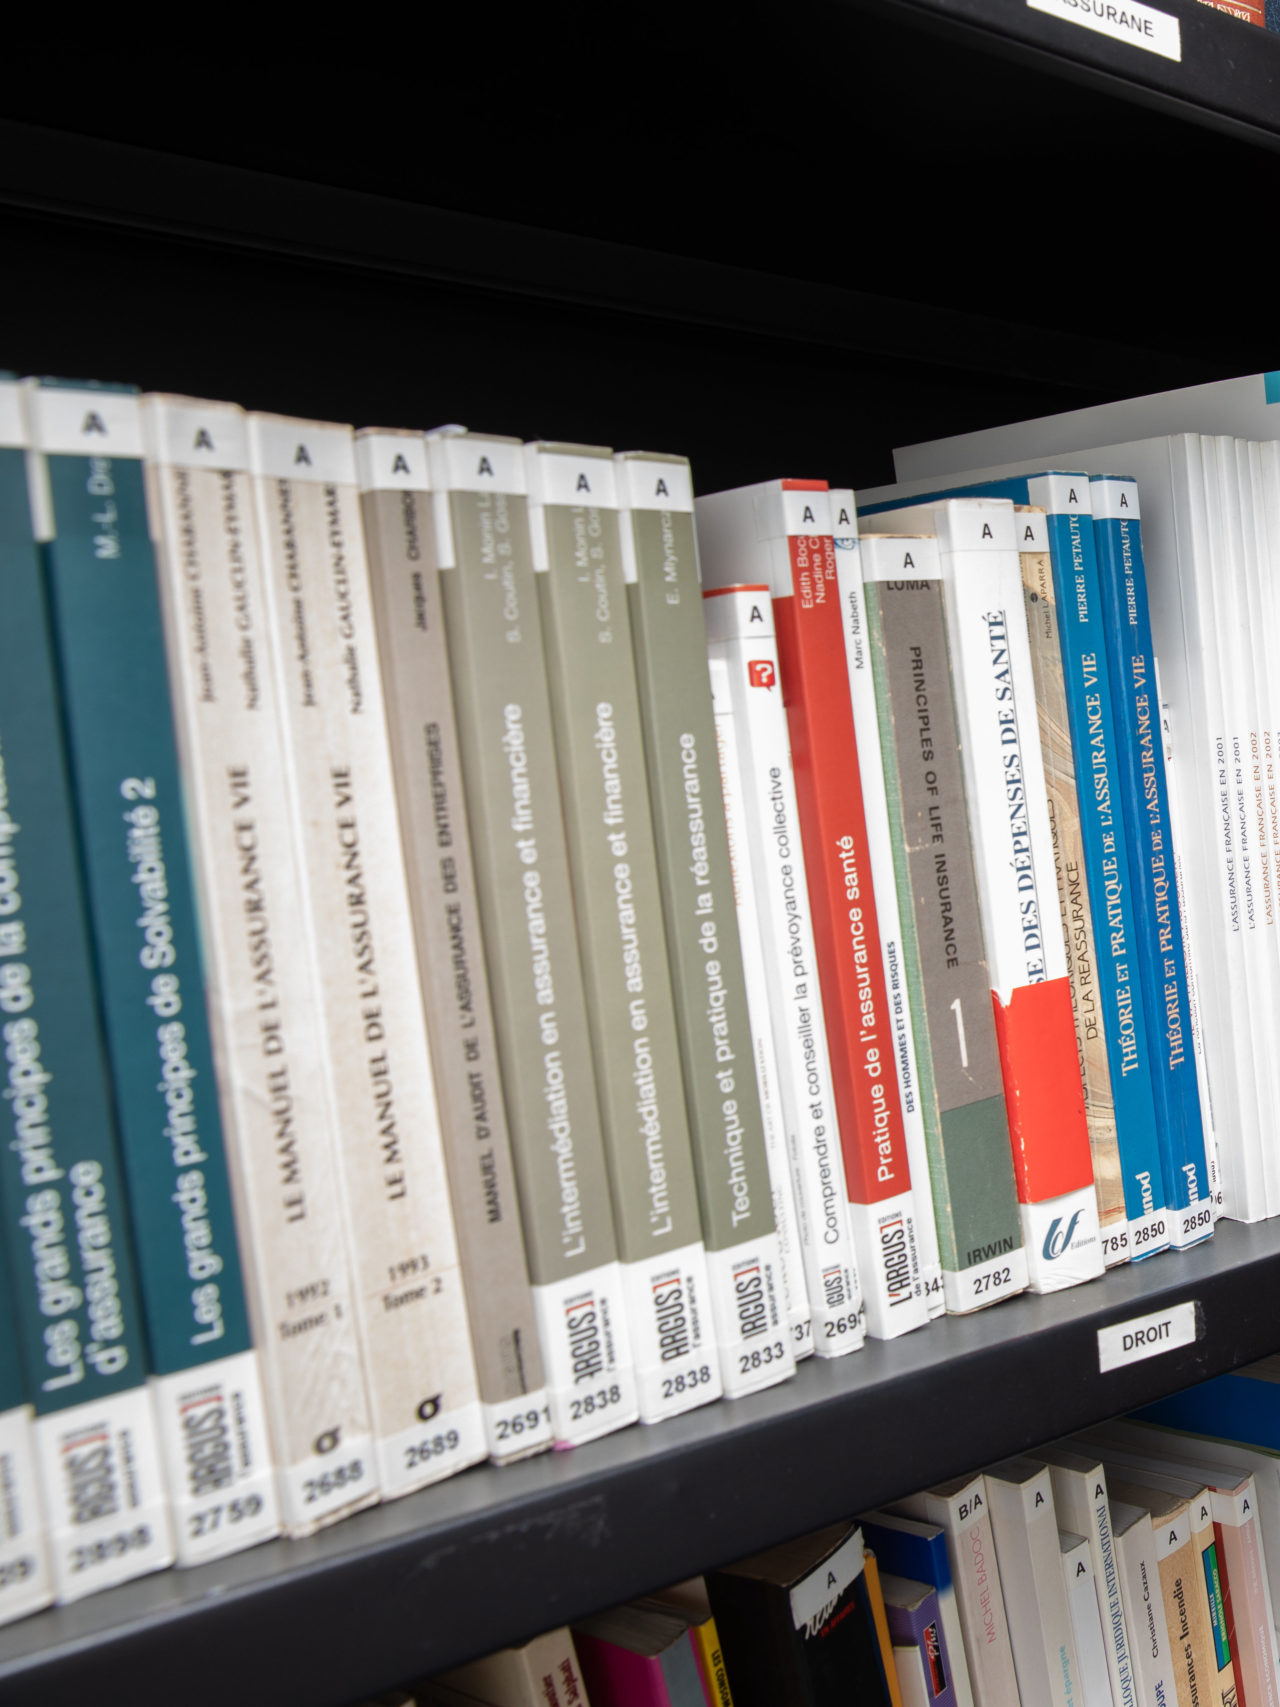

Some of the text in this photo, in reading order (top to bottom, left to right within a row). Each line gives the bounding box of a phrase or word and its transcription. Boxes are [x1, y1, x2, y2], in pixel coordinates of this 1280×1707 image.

[1062, 0, 1154, 38] SSURANE
[812, 549, 826, 604] Nadine
[823, 536, 836, 581] Roger
[801, 577, 814, 609] Edith
[847, 590, 866, 670] Marc Nabeth
[1216, 735, 1226, 765] 2001
[1219, 771, 1227, 786] EN
[1232, 735, 1242, 764] 2001
[1236, 770, 1243, 785] EN
[909, 646, 959, 969] PRINCIPLES OF LIFE INSURANCE
[982, 608, 1042, 962] DES DÉPENSES DE SANTÉ
[120, 775, 177, 970] Solvabilité 2
[1081, 652, 1139, 1078] THÉORIE ET PRATIQUE DE L'ASSURANCE VIE
[1226, 852, 1240, 932] L'ASSURANCE
[1242, 851, 1256, 930] L'ASSURANCE
[331, 764, 407, 1202] LE MANUEL DE L'ASSURANCE VIE
[503, 701, 586, 1260] L'intermédiation en assurance et financière
[594, 701, 673, 1237] L'intermédiation en assurance et financière
[680, 732, 751, 1228] Technique et pratique de la réassurance
[767, 765, 840, 1247] Comprendre et conseiller la prévoyance collective
[834, 833, 896, 1183] Pratique de l'assurance santé
[886, 940, 917, 1114] DES HOMMES ET DES RISQUES
[146, 972, 226, 1346] Les grands principes de
[3, 1016, 85, 1392] Les grands principes
[1134, 1220, 1165, 1246] 2850
[1183, 1209, 1211, 1234] 2850
[69, 1159, 129, 1377] d'assurance
[967, 1234, 1014, 1266] IRWIN
[972, 1267, 1012, 1296] 2782
[739, 1341, 786, 1374] 2833
[1122, 1320, 1173, 1352] DROIT
[569, 1383, 622, 1421] 2838
[661, 1365, 713, 1398] 2838
[404, 1428, 460, 1469] 2689
[495, 1405, 552, 1441] 2691
[957, 1493, 983, 1521] B/A
[969, 1525, 997, 1645] MICHEL BADOC
[1173, 1577, 1192, 1642] Incendie
[1144, 1600, 1160, 1659] Christiane
